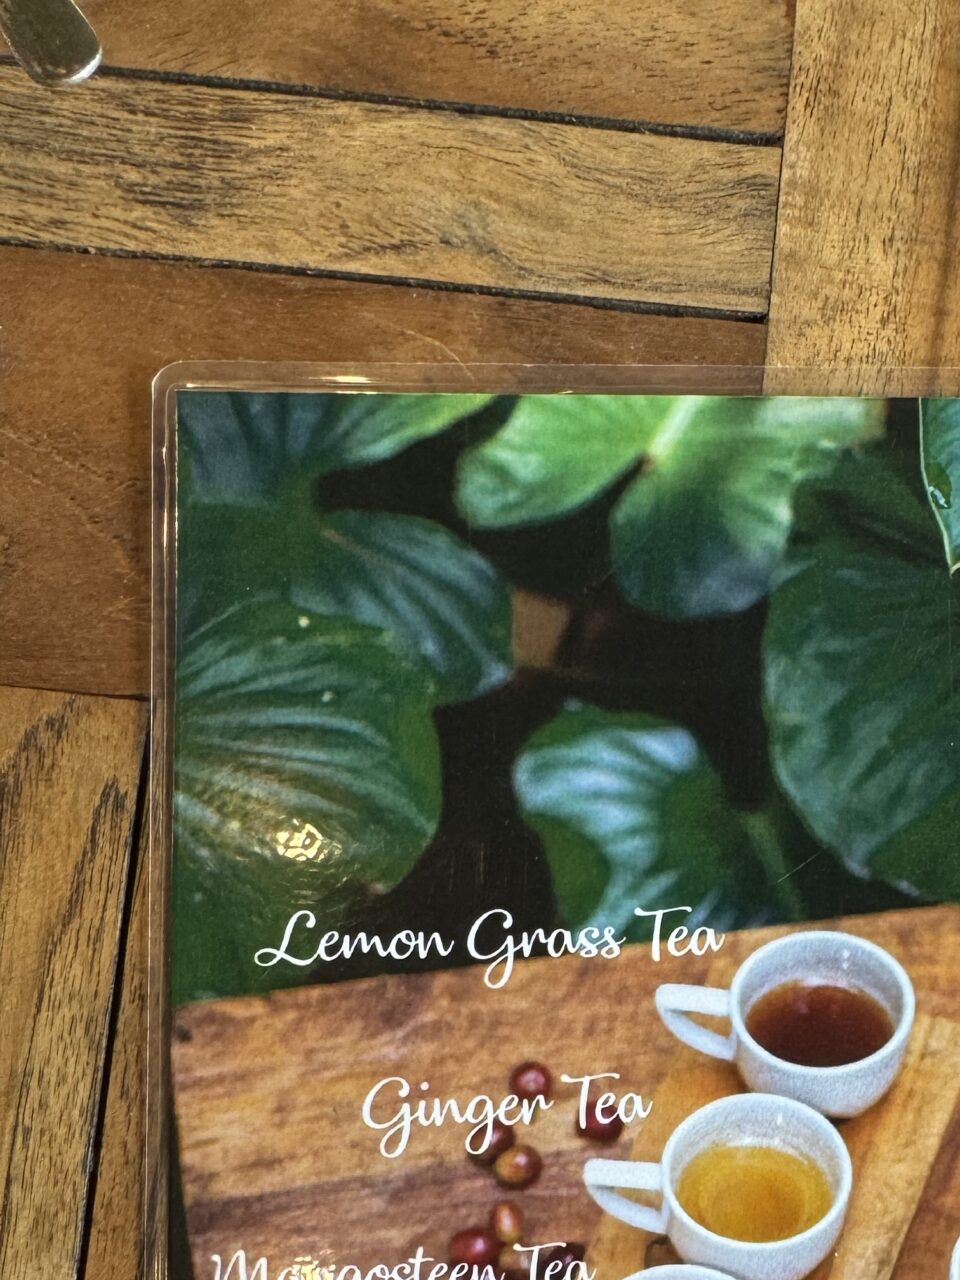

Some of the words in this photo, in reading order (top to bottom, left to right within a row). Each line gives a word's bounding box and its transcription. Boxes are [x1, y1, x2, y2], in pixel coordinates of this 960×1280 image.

[254, 910, 455, 967] Lemon
[467, 909, 627, 988] Grass
[634, 906, 725, 962] Tea
[362, 1077, 555, 1158] Ginger
[560, 1072, 653, 1127] Tea
